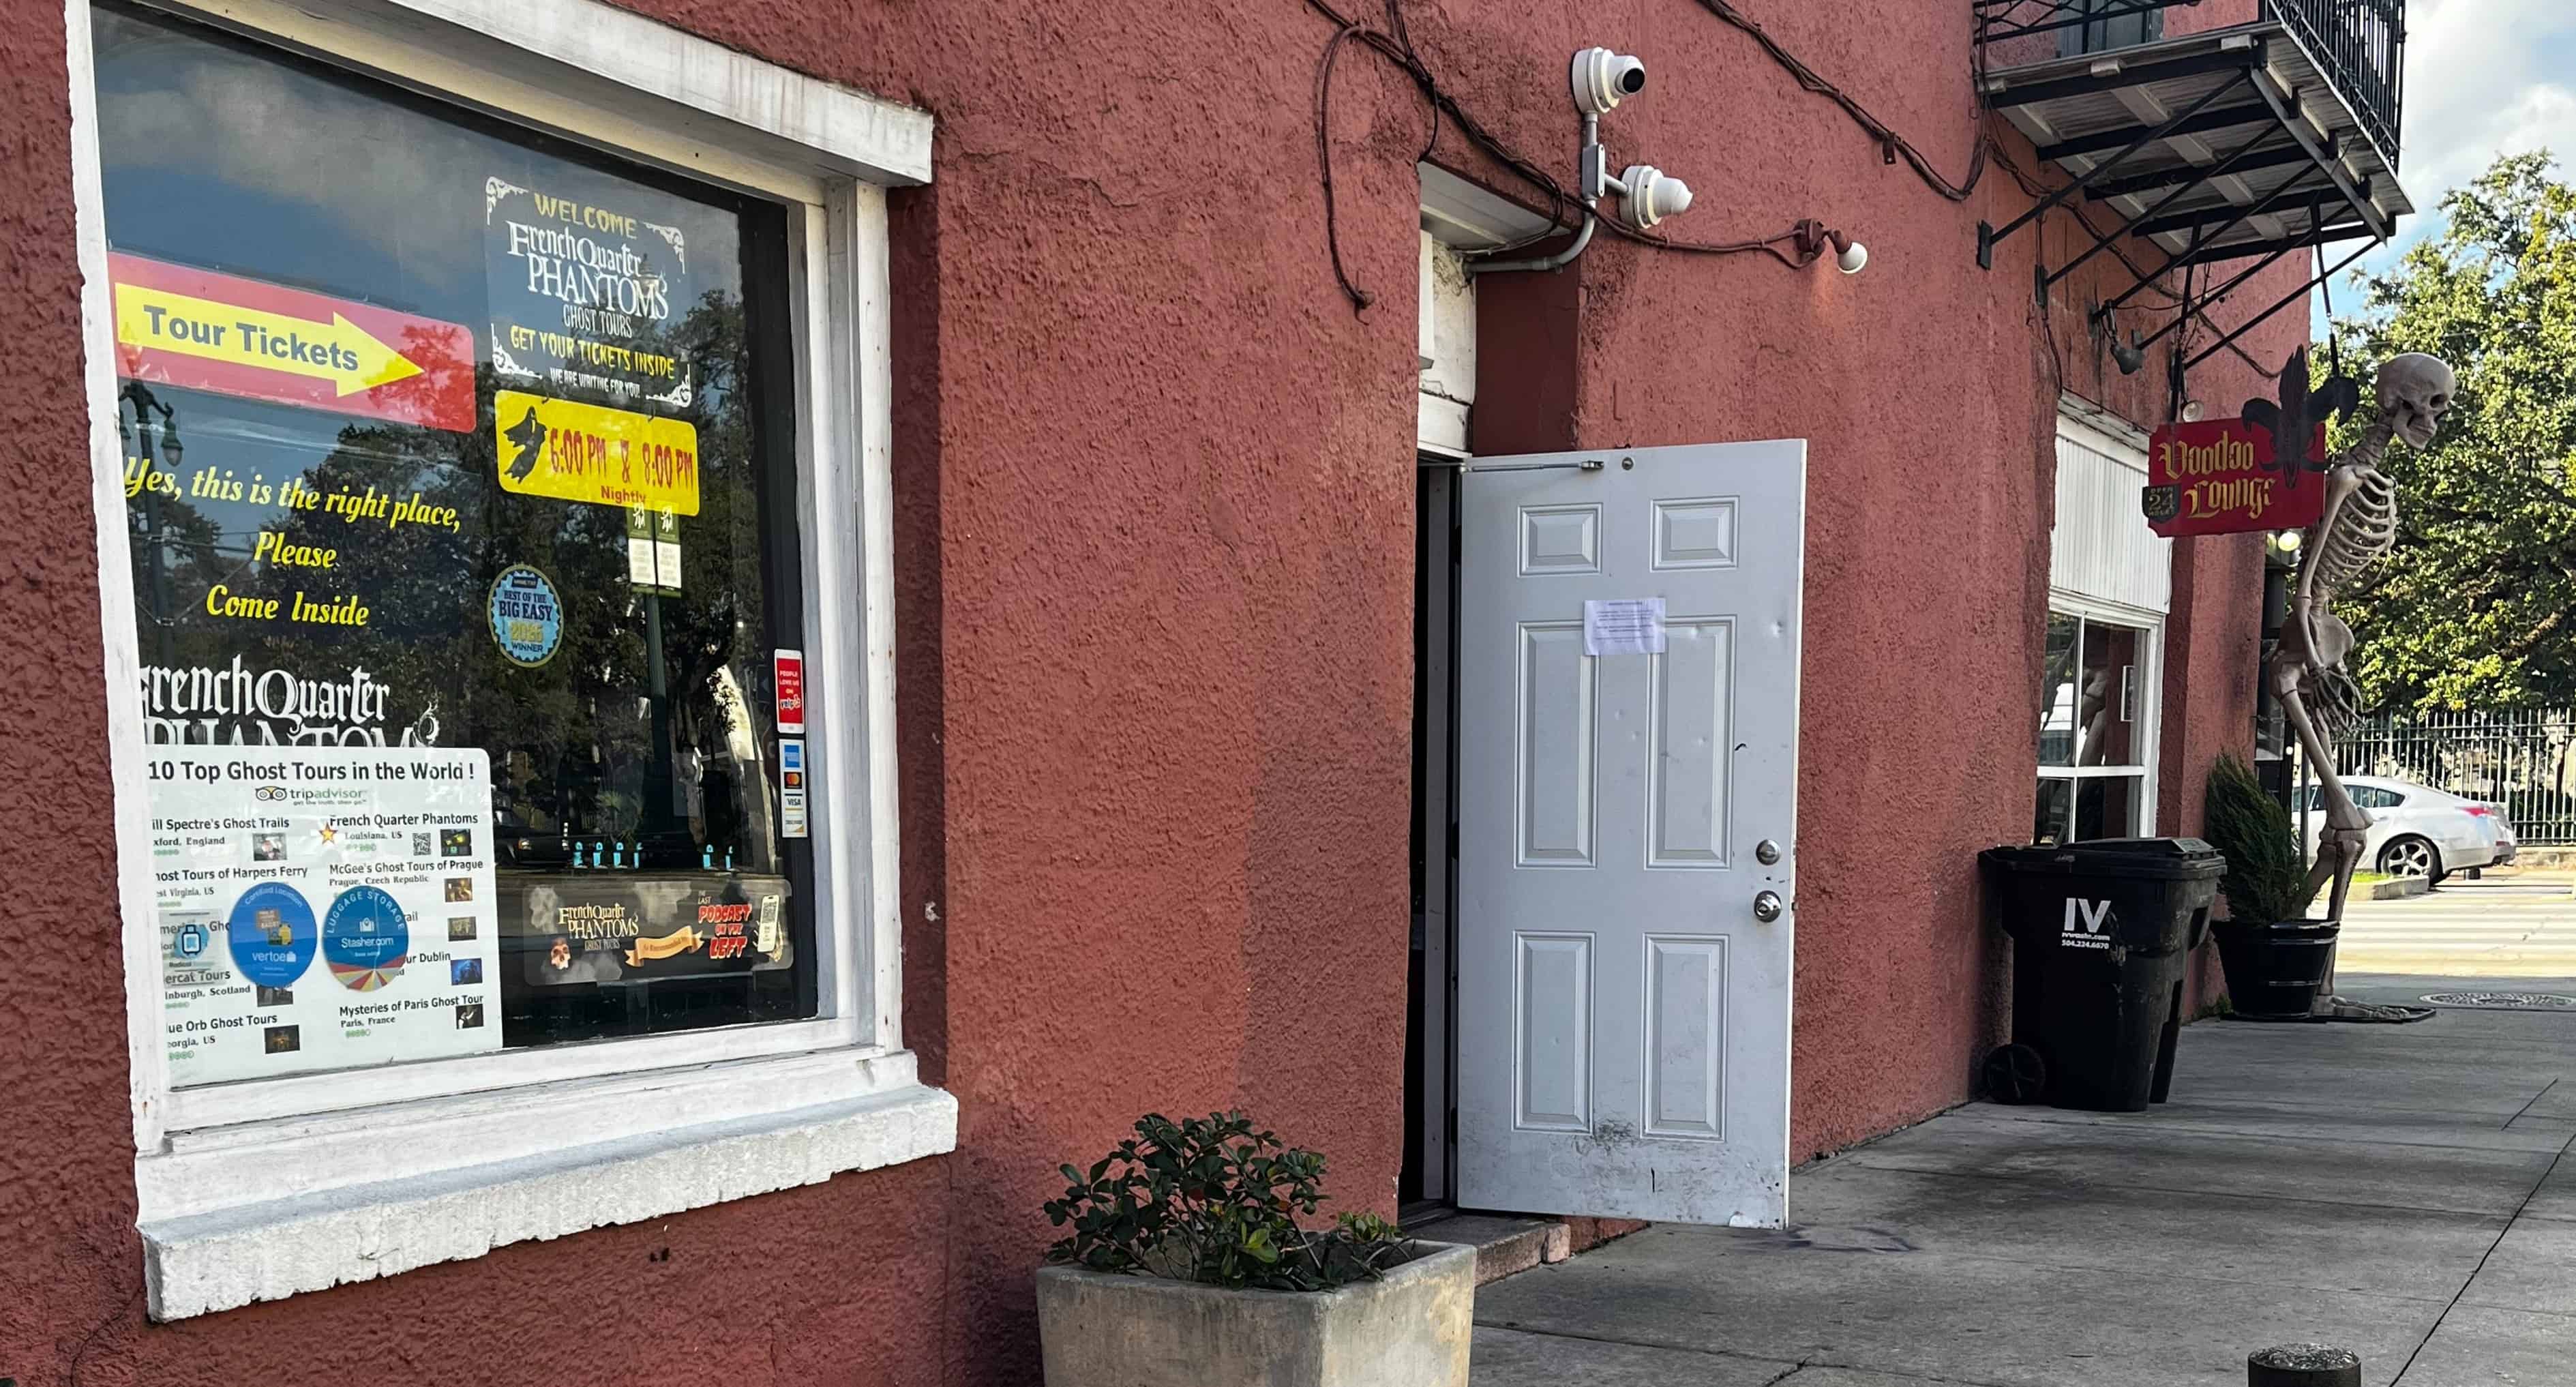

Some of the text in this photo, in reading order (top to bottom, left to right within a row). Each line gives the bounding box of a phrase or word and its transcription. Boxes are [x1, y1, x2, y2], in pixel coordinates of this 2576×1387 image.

[535, 193, 637, 239] WELCOME
[528, 253, 669, 320] PHANTOMS
[563, 304, 633, 338] GHOST TOURS
[143, 304, 359, 371] Tour Tickets
[510, 325, 675, 379] GET YOUR TICKETS INSIDE
[550, 367, 563, 384] WE
[564, 370, 578, 387] ARE
[610, 379, 623, 395] FOR
[624, 382, 641, 399] YOU!
[550, 428, 693, 492] 6:00 PM & 8:00 PM
[2157, 431, 2254, 479] Voodoo
[124, 456, 462, 534] Yes, this is the right place,
[601, 485, 646, 505] Nightly
[2148, 493, 2174, 510] 24
[2184, 478, 2277, 519] Lounge
[254, 531, 337, 569] Please
[206, 584, 370, 626] Come Inside
[503, 591, 522, 600] BEST
[522, 593, 532, 602] OF
[499, 601, 553, 621] BIG EASY
[512, 642, 543, 653] WINNER
[148, 761, 175, 779] 10
[180, 761, 221, 784] Top
[227, 761, 287, 780] Ghost
[291, 762, 346, 780] Tours
[352, 762, 370, 780] in
[375, 762, 406, 780] the
[410, 762, 464, 780] World
[290, 788, 364, 801] tripadvisor
[787, 797, 802, 807] VISA
[152, 817, 290, 832] ill Spectre's Ghost Trails
[329, 813, 479, 828] French Quarter Phantoms
[153, 837, 225, 847] xford, England
[391, 831, 402, 839] US
[182, 869, 215, 880] Tours
[218, 868, 230, 879] of
[233, 867, 276, 880] Harpers
[280, 866, 308, 878] Ferry
[329, 860, 484, 874] McGee's Ghost Tours of Prague
[365, 876, 390, 884] Czech
[393, 876, 430, 884] Republic
[204, 887, 214, 895] US
[327, 891, 363, 934] LUGGAGE
[367, 891, 405, 931] STORAGE
[698, 904, 752, 923] PODCAST
[2064, 897, 2112, 933] IV
[568, 913, 639, 939] PHANTOMS
[341, 936, 394, 949] Stasher.com
[709, 936, 747, 959] LEFT
[252, 952, 286, 961] vertoe
[419, 951, 451, 962] Dublin
[166, 971, 230, 983] ercat Tours
[209, 985, 251, 996] Scotland
[340, 995, 484, 1017] Mysteries of Paris Ghost Tour
[186, 1019, 207, 1032] Orb
[210, 1017, 243, 1029] Ghost
[246, 1015, 278, 1025] Tours
[368, 1015, 395, 1025] France
[203, 1035, 215, 1044] US
